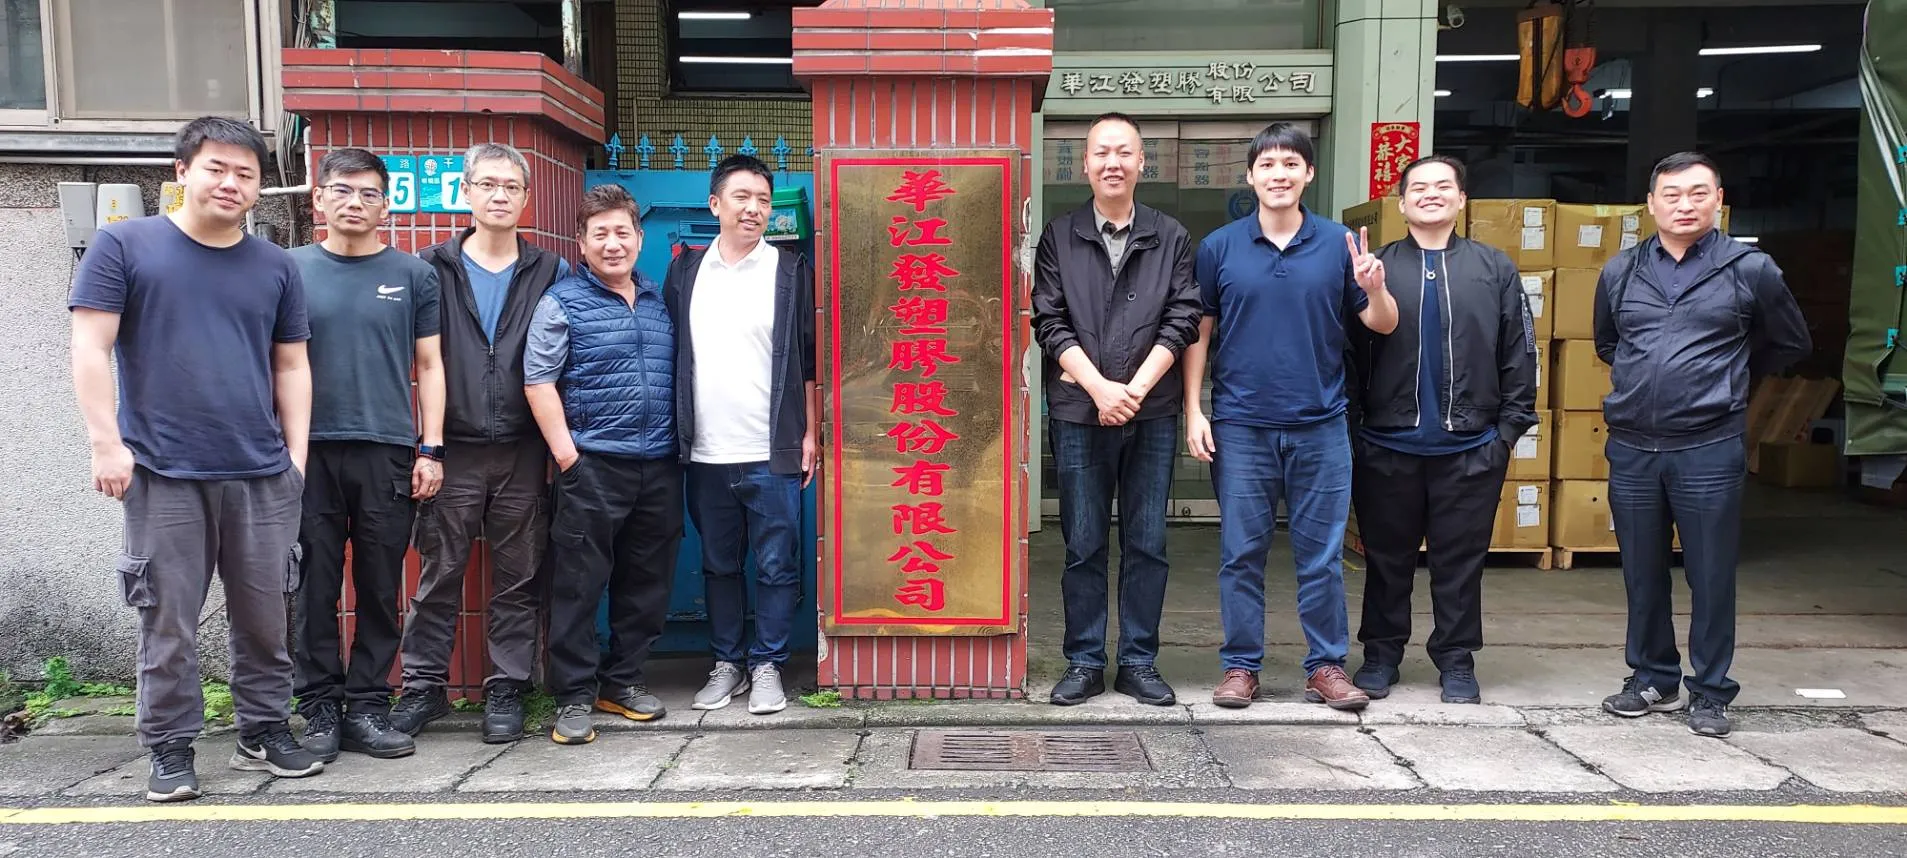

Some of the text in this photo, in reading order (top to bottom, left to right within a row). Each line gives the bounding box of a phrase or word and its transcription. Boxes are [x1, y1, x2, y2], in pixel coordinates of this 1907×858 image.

[1060, 61, 1317, 104] 華江發塑膠 股份 有限 公司
[886, 170, 961, 612] 華江發塑膠股份有限公司
